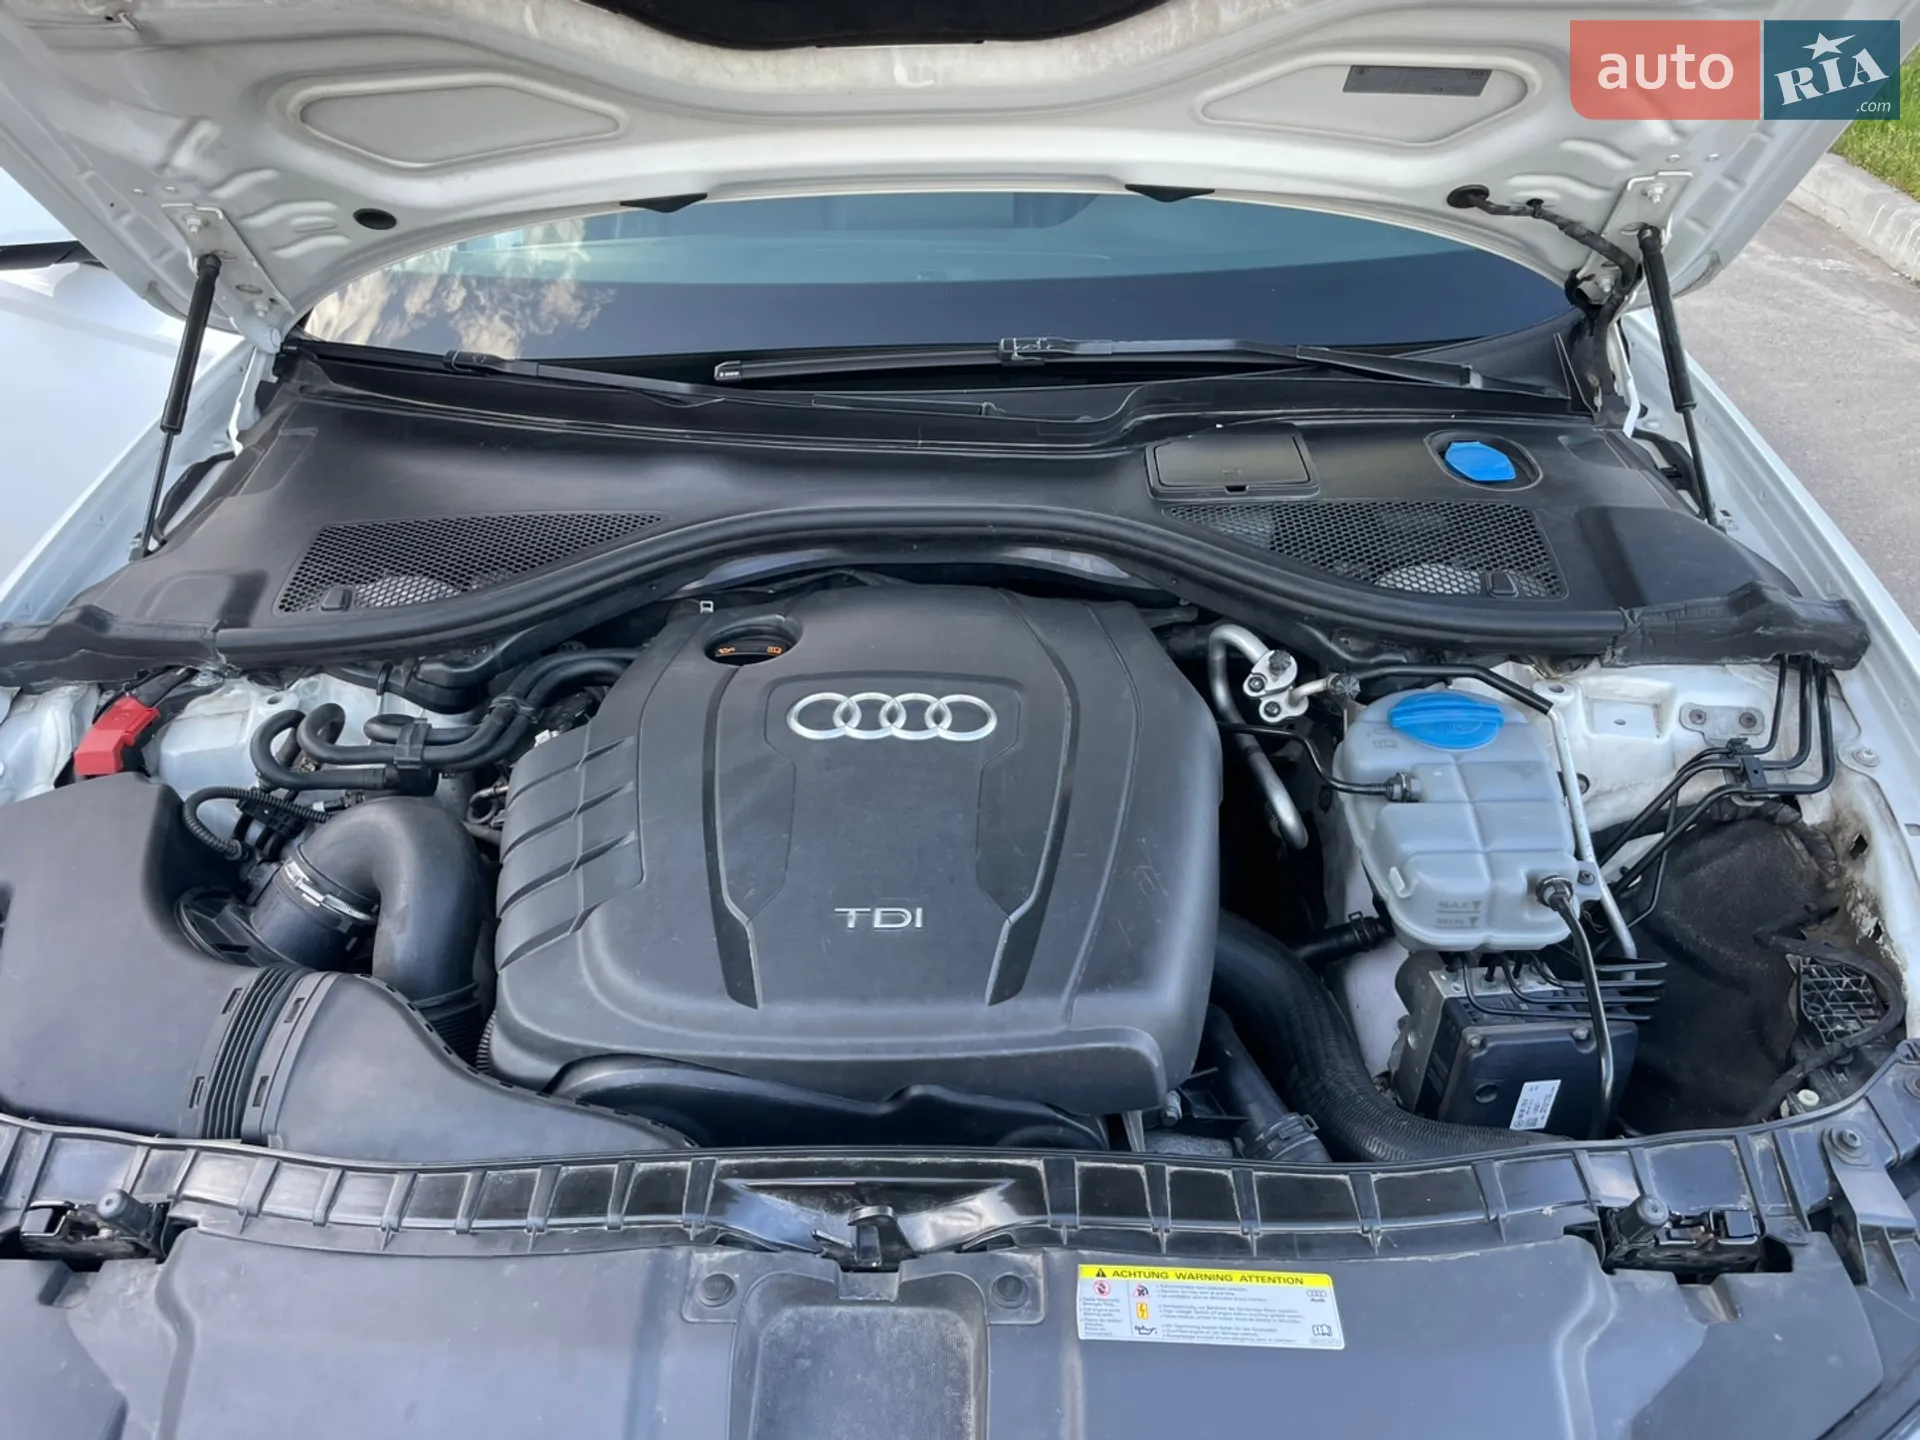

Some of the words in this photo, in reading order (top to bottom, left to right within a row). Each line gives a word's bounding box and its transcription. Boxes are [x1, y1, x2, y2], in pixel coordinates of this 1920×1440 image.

[834, 907, 922, 929] TDI
[1111, 1269, 1169, 1280] ACHTUNG
[1175, 1272, 1233, 1283] WARNING
[1239, 1274, 1304, 1285] ATTENTION
